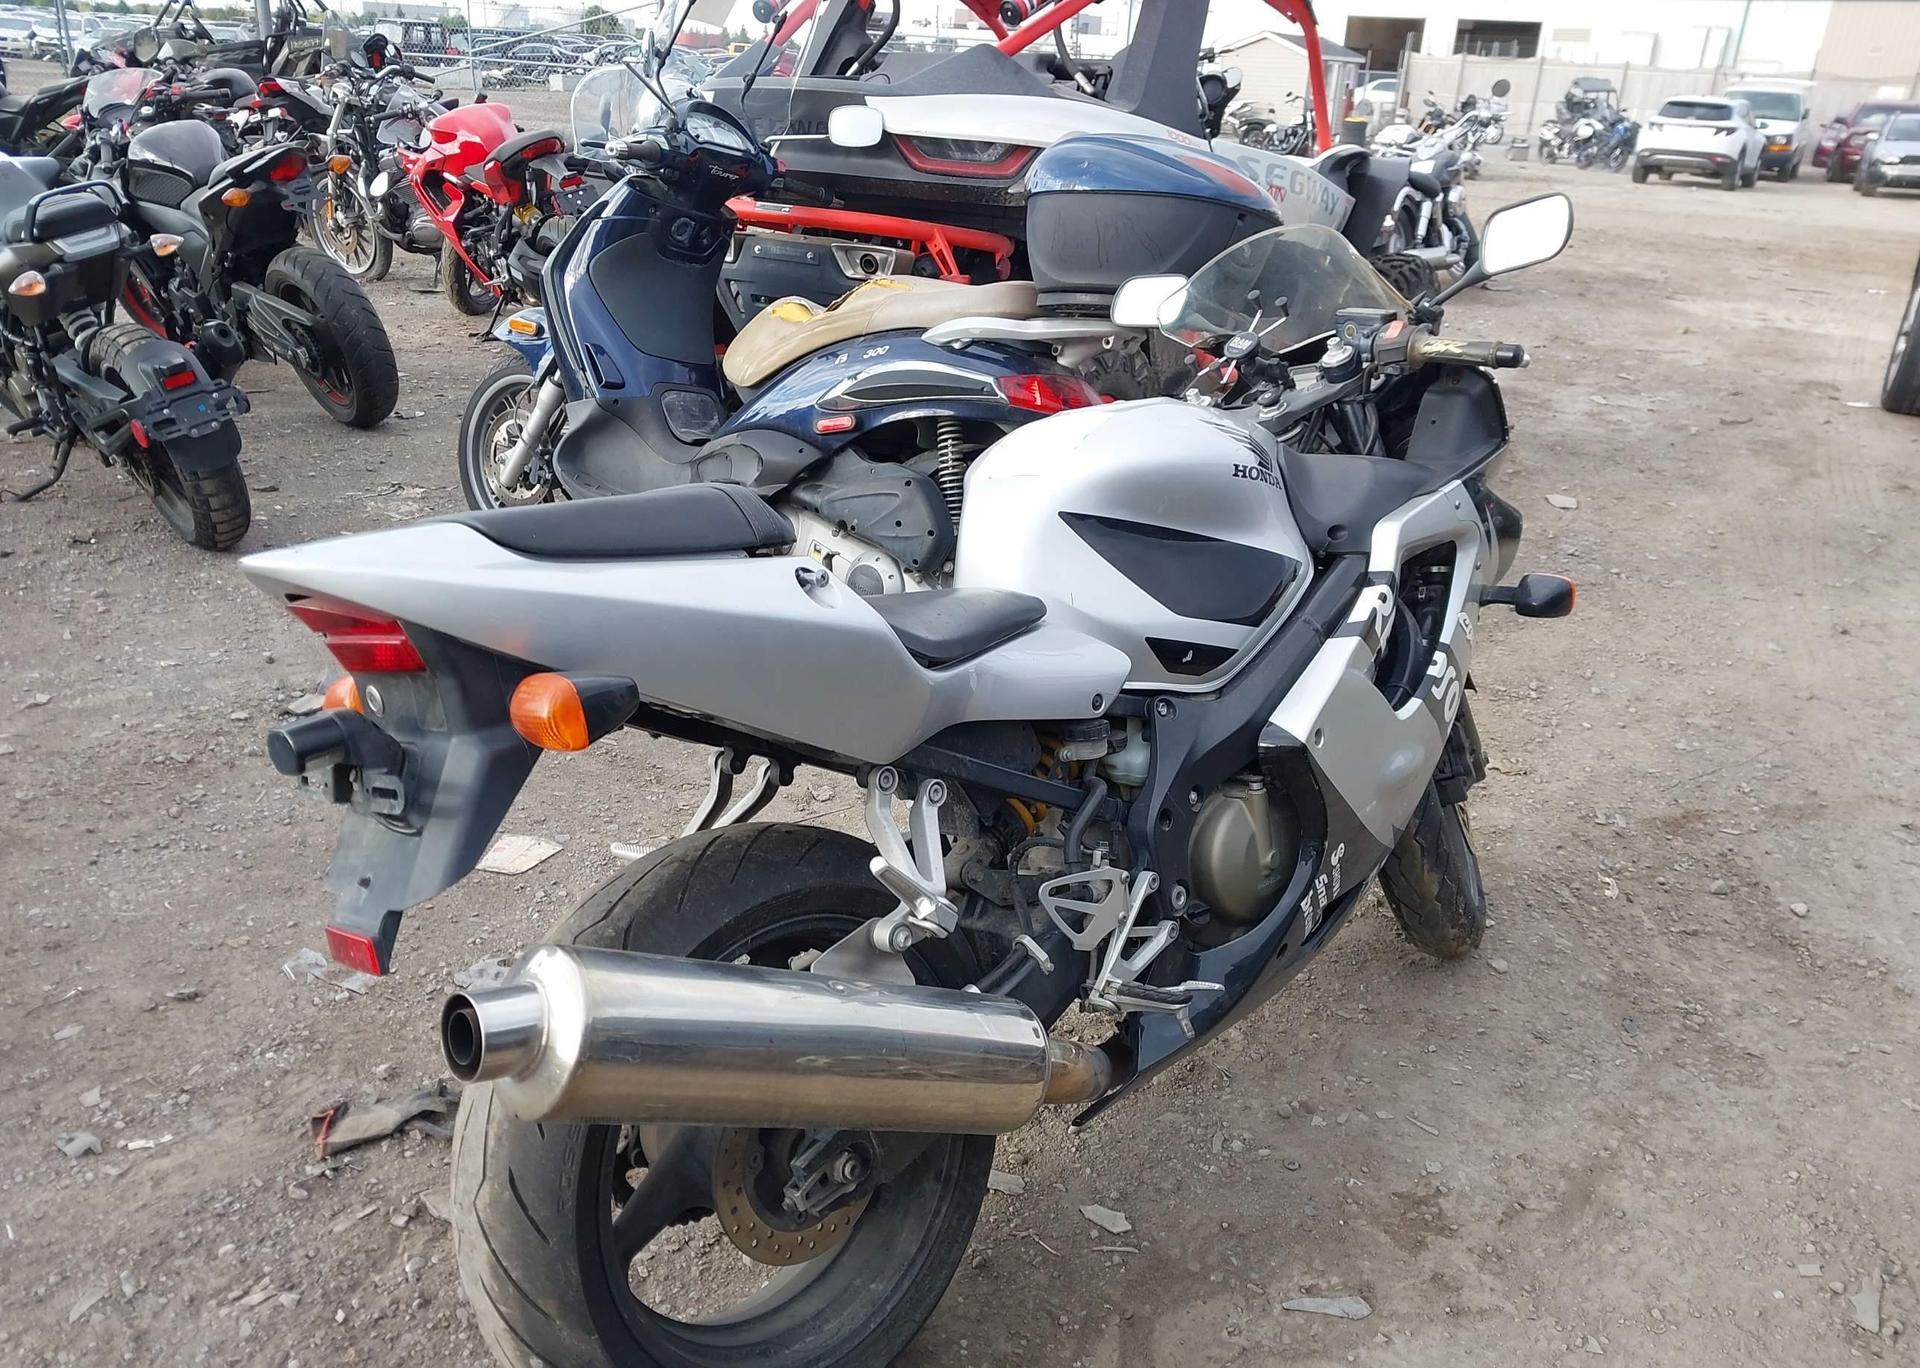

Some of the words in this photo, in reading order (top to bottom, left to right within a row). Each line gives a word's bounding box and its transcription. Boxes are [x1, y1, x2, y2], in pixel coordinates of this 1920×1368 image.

[1236, 154, 1340, 216] SEGWAY
[862, 344, 891, 360] 300
[1232, 463, 1283, 490] HONDA
